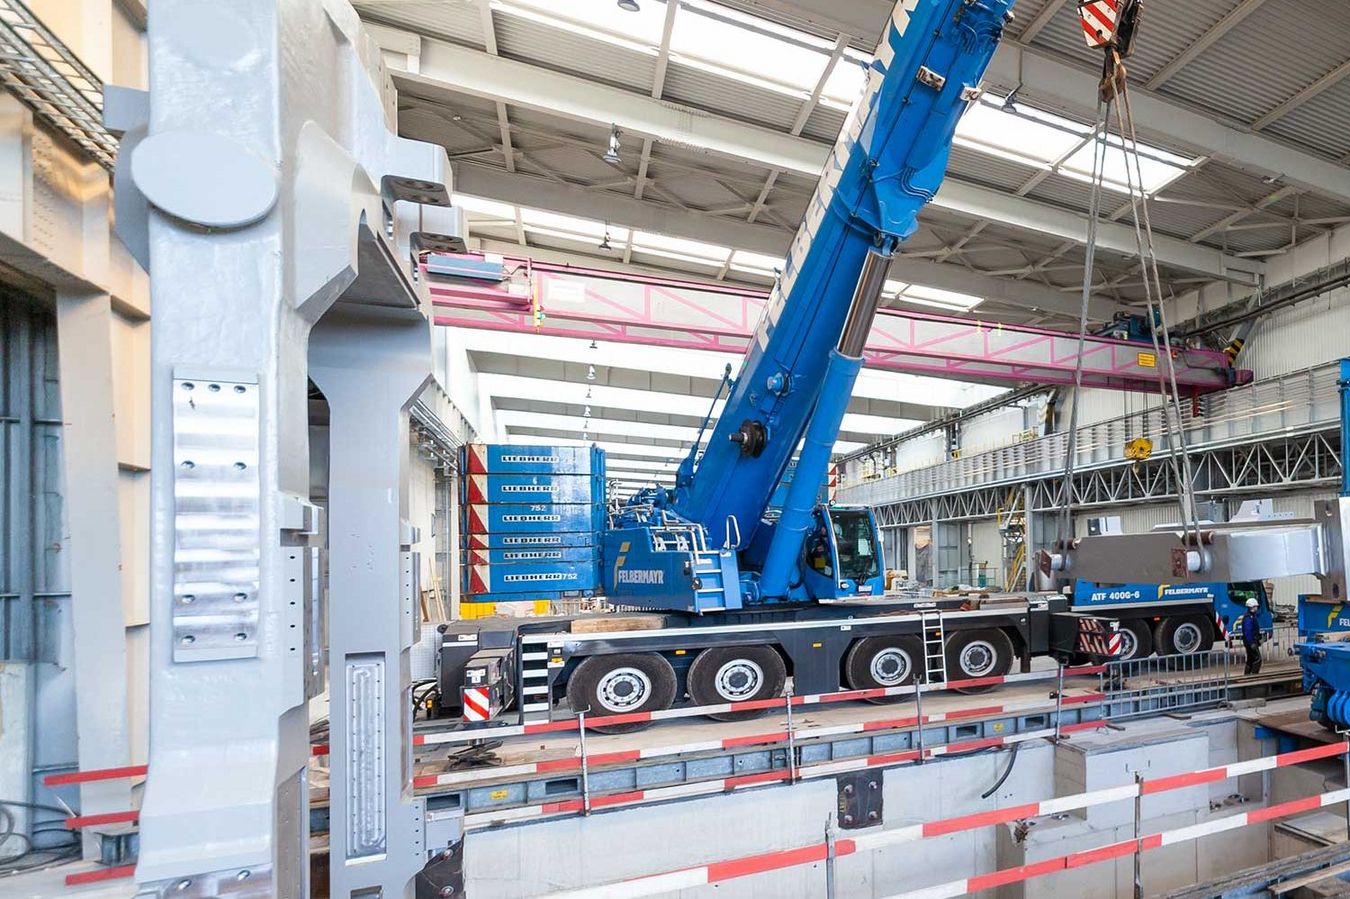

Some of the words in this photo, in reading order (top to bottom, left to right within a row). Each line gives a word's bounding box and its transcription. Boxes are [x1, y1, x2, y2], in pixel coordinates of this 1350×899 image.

[618, 570, 664, 585] FELBERMAYR
[1091, 592, 1107, 601] ATF
[1109, 590, 1140, 600] 400G-6
[1164, 587, 1209, 596] FELBERMAYR
